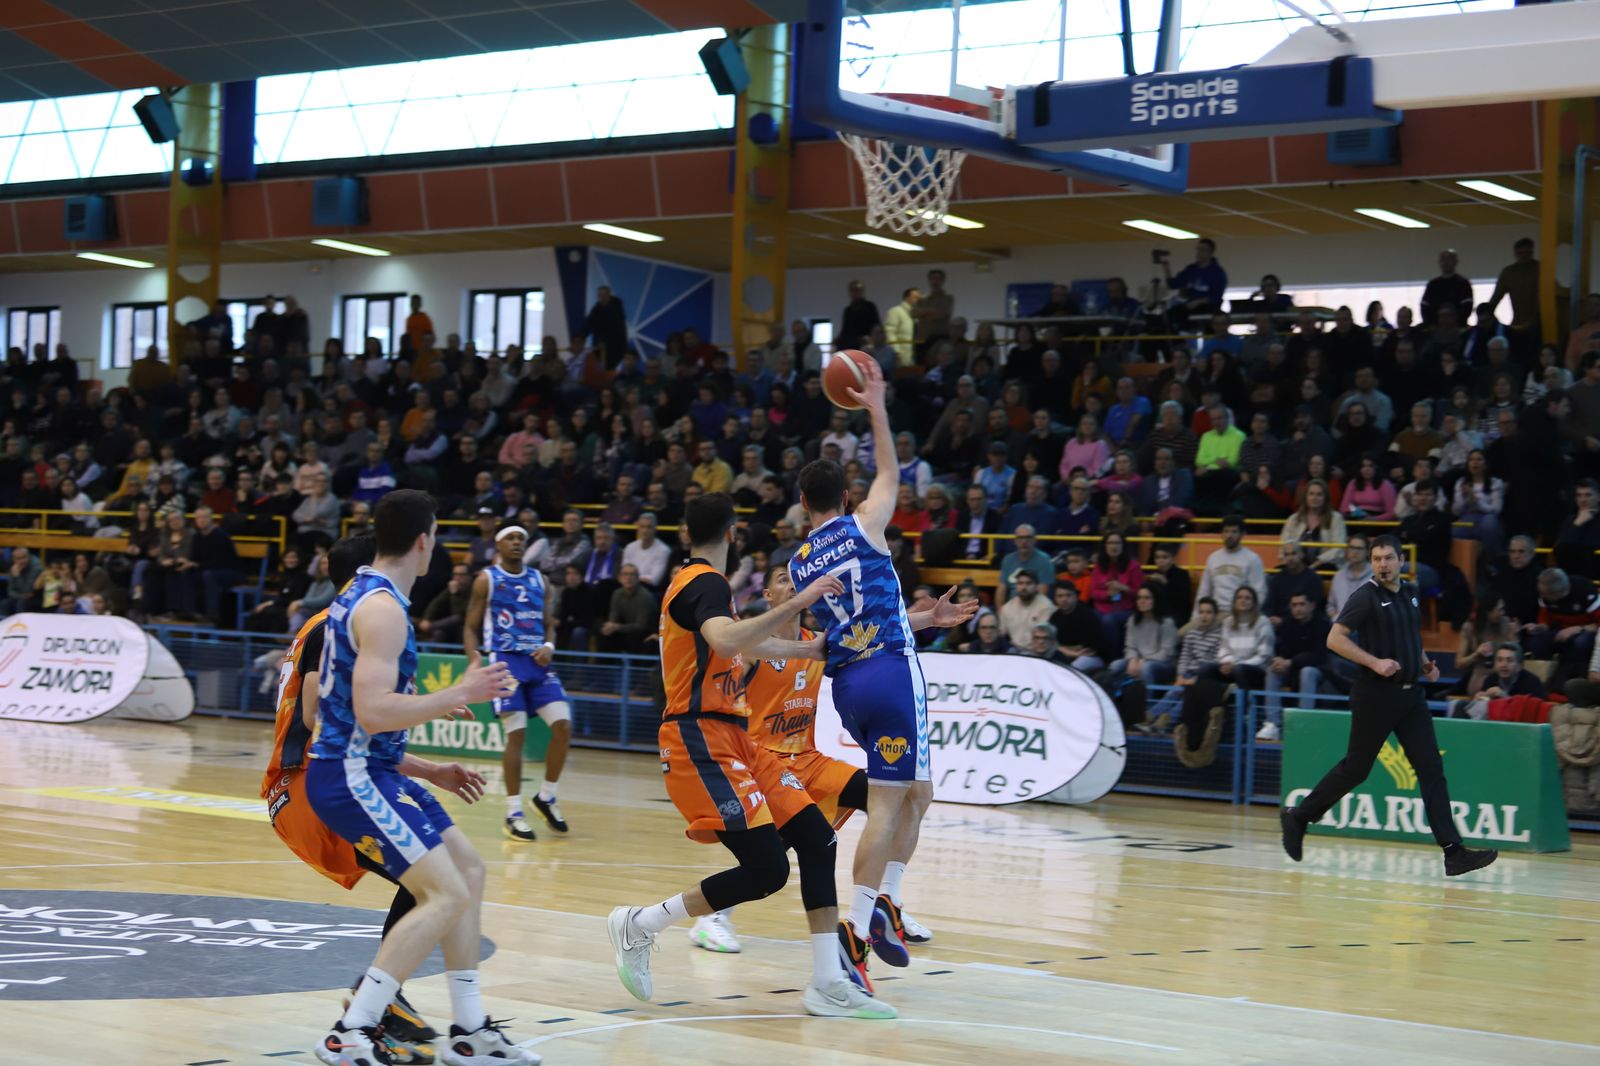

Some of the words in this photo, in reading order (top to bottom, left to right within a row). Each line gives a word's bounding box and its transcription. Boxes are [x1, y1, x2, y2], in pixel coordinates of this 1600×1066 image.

[1131, 77, 1239, 102] Schelde
[1130, 97, 1238, 126] Sports
[797, 538, 858, 581] NASPLER
[514, 585, 529, 603] 2
[20, 666, 114, 693] ZAMORA
[795, 670, 807, 691] 6
[432, 719, 507, 752] RURA
[874, 742, 911, 755] ZAMORA
[927, 720, 1048, 760] AMORA
